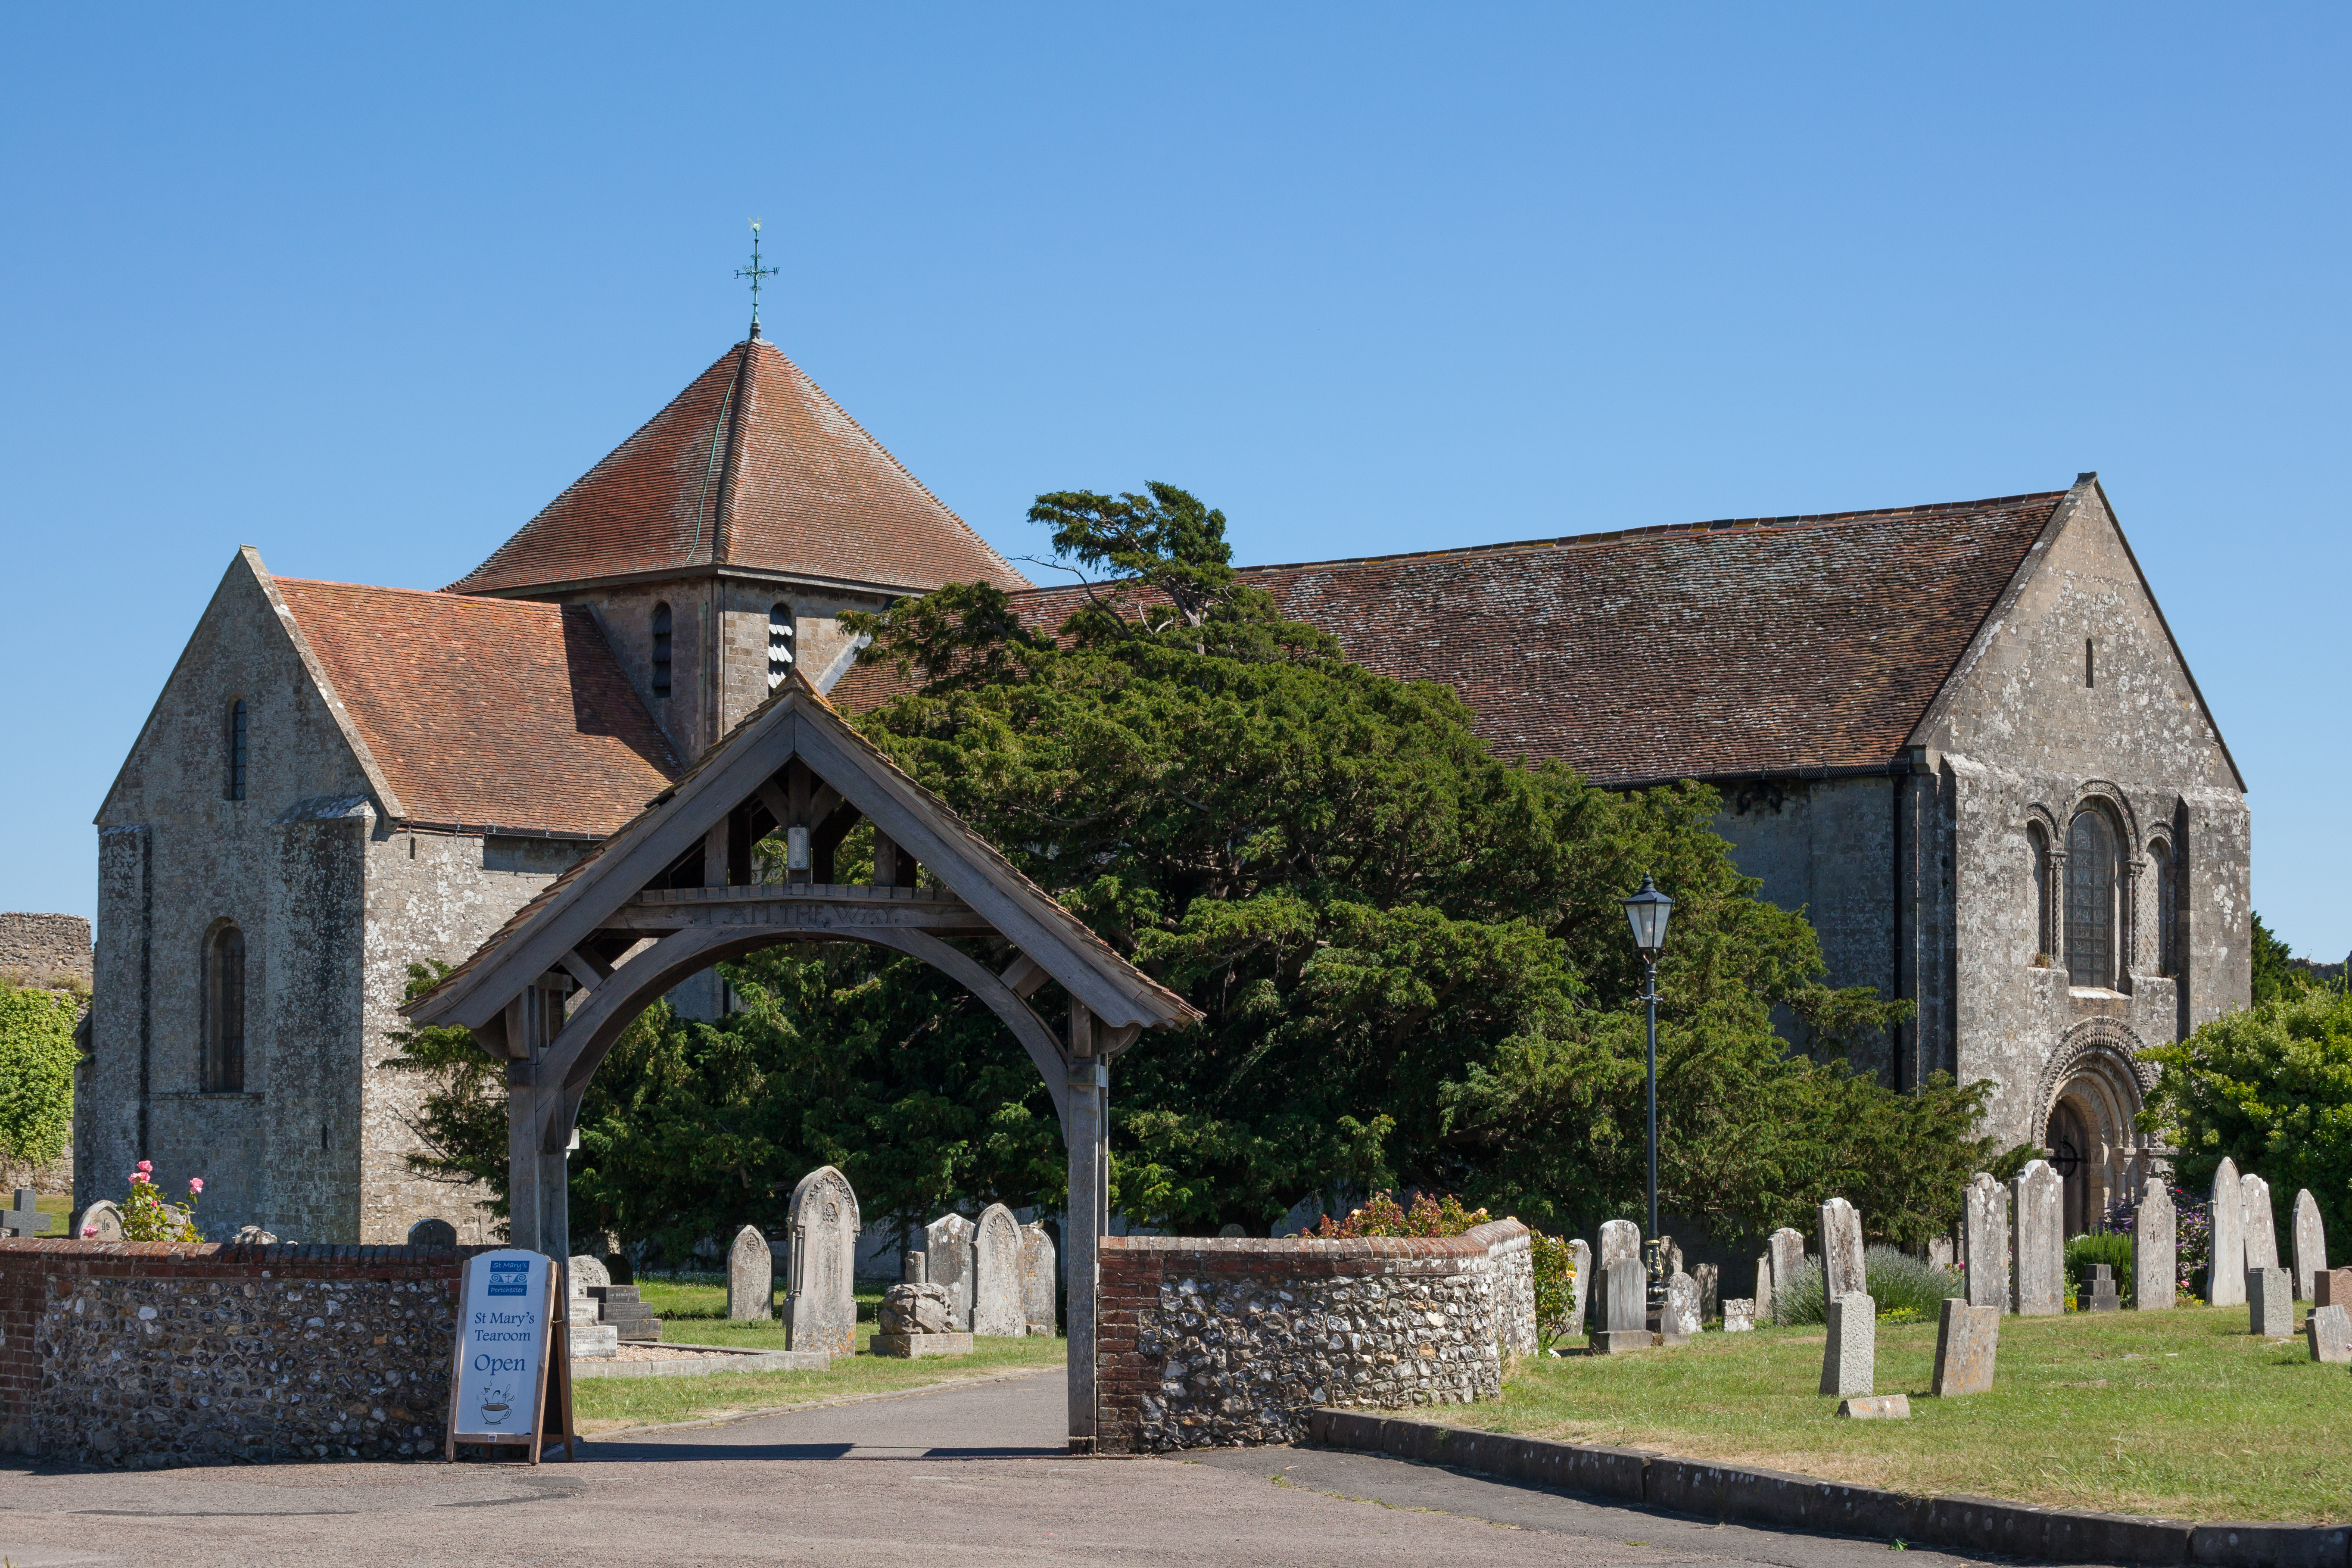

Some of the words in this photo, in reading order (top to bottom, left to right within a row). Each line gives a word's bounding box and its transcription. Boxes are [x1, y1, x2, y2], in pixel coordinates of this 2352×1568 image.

[706, 906, 712, 924] I
[779, 905, 824, 924] THE
[503, 1262, 527, 1271] Mary's
[474, 1312, 486, 1324] St
[489, 1312, 535, 1327] Mary's
[475, 1329, 531, 1341] Tearoom
[474, 1354, 526, 1376] Open
